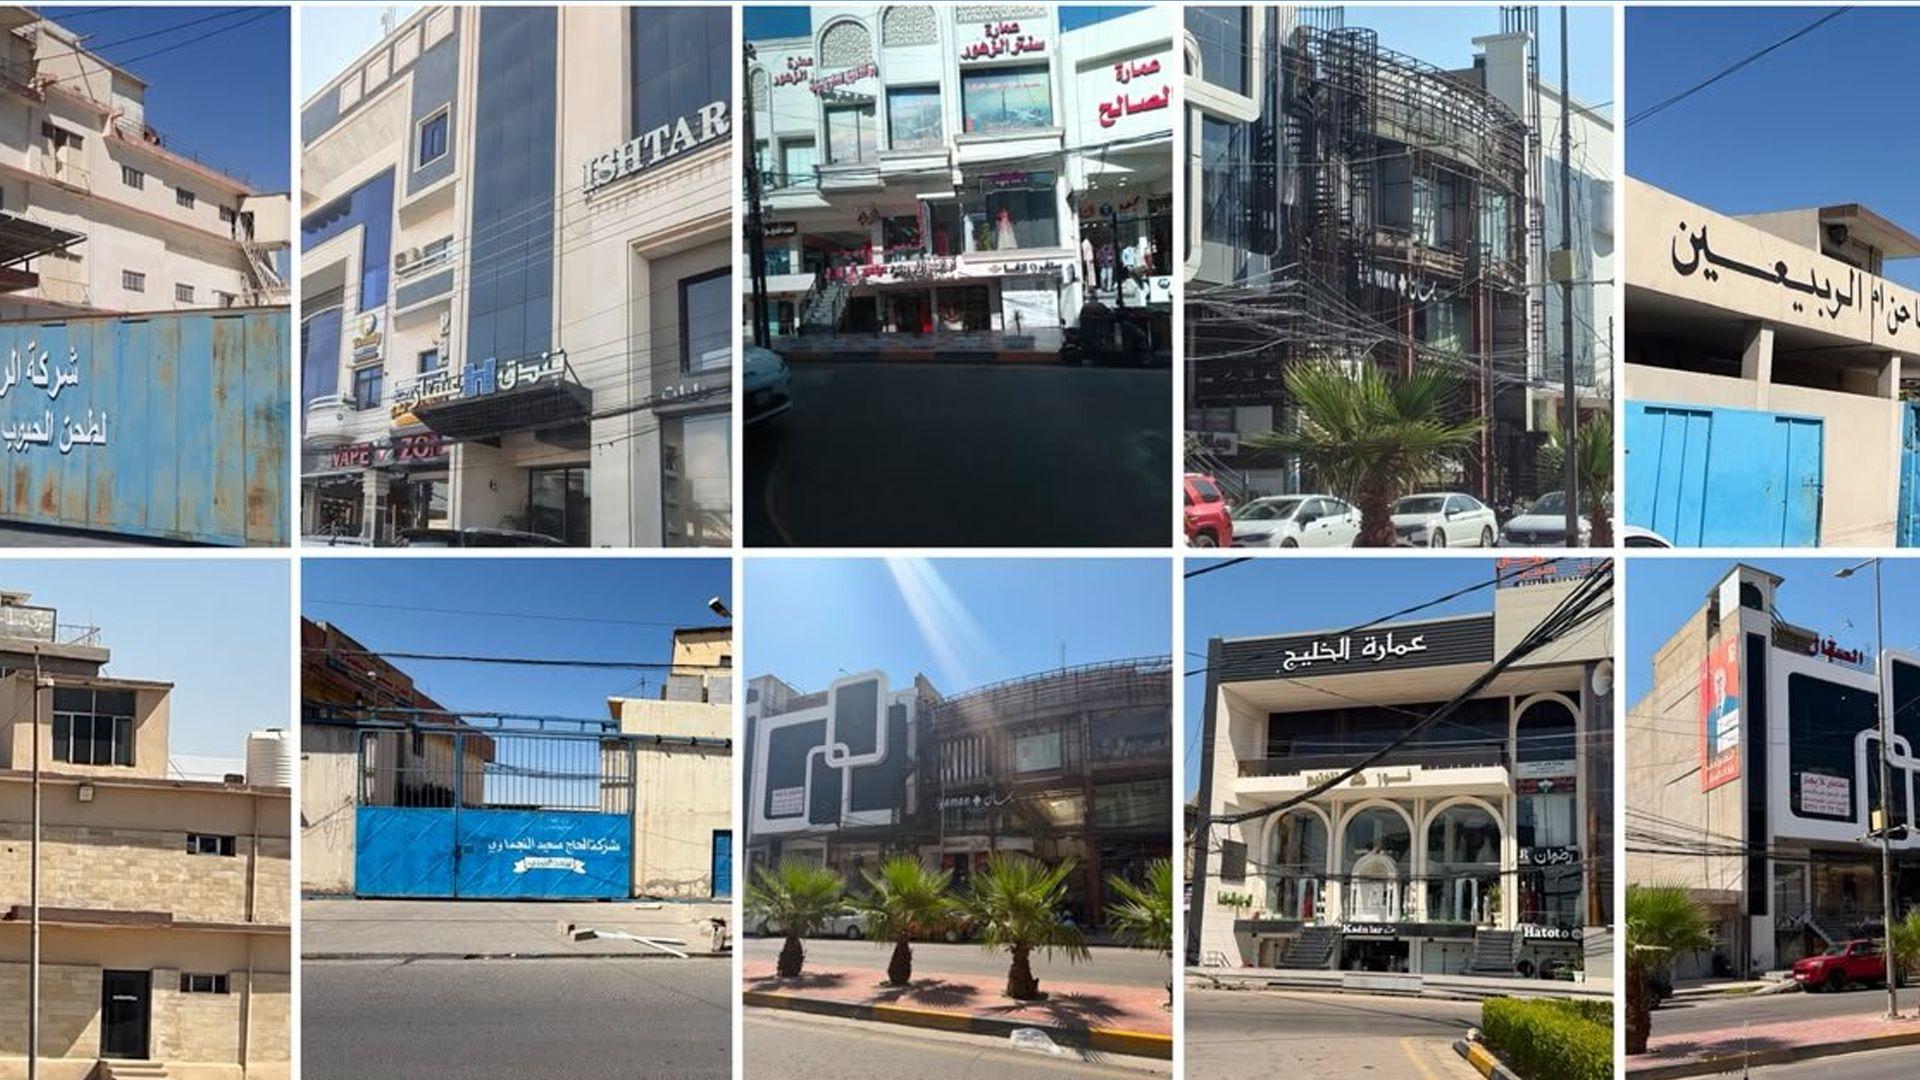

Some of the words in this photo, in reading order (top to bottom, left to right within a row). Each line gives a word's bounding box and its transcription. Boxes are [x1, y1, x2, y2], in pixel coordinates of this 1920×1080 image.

[985, 22, 1020, 39] عمارة
[962, 39, 1009, 60] الزهور
[1115, 58, 1160, 84] عمارة
[1098, 85, 1173, 128] لصالح
[583, 101, 731, 194] ISHTAR
[1672, 221, 1862, 319] الربيعين
[27, 340, 79, 400] شركة
[498, 347, 566, 391] فندق
[2, 409, 54, 453] الحبوب
[60, 408, 107, 453] لطحن
[332, 443, 369, 468] VAPE
[1283, 636, 1350, 671] الخليج
[1362, 632, 1427, 661] عمارة
[537, 841, 563, 853] سعيد
[591, 838, 620, 855] شركة
[1535, 847, 1573, 865] رضوان
